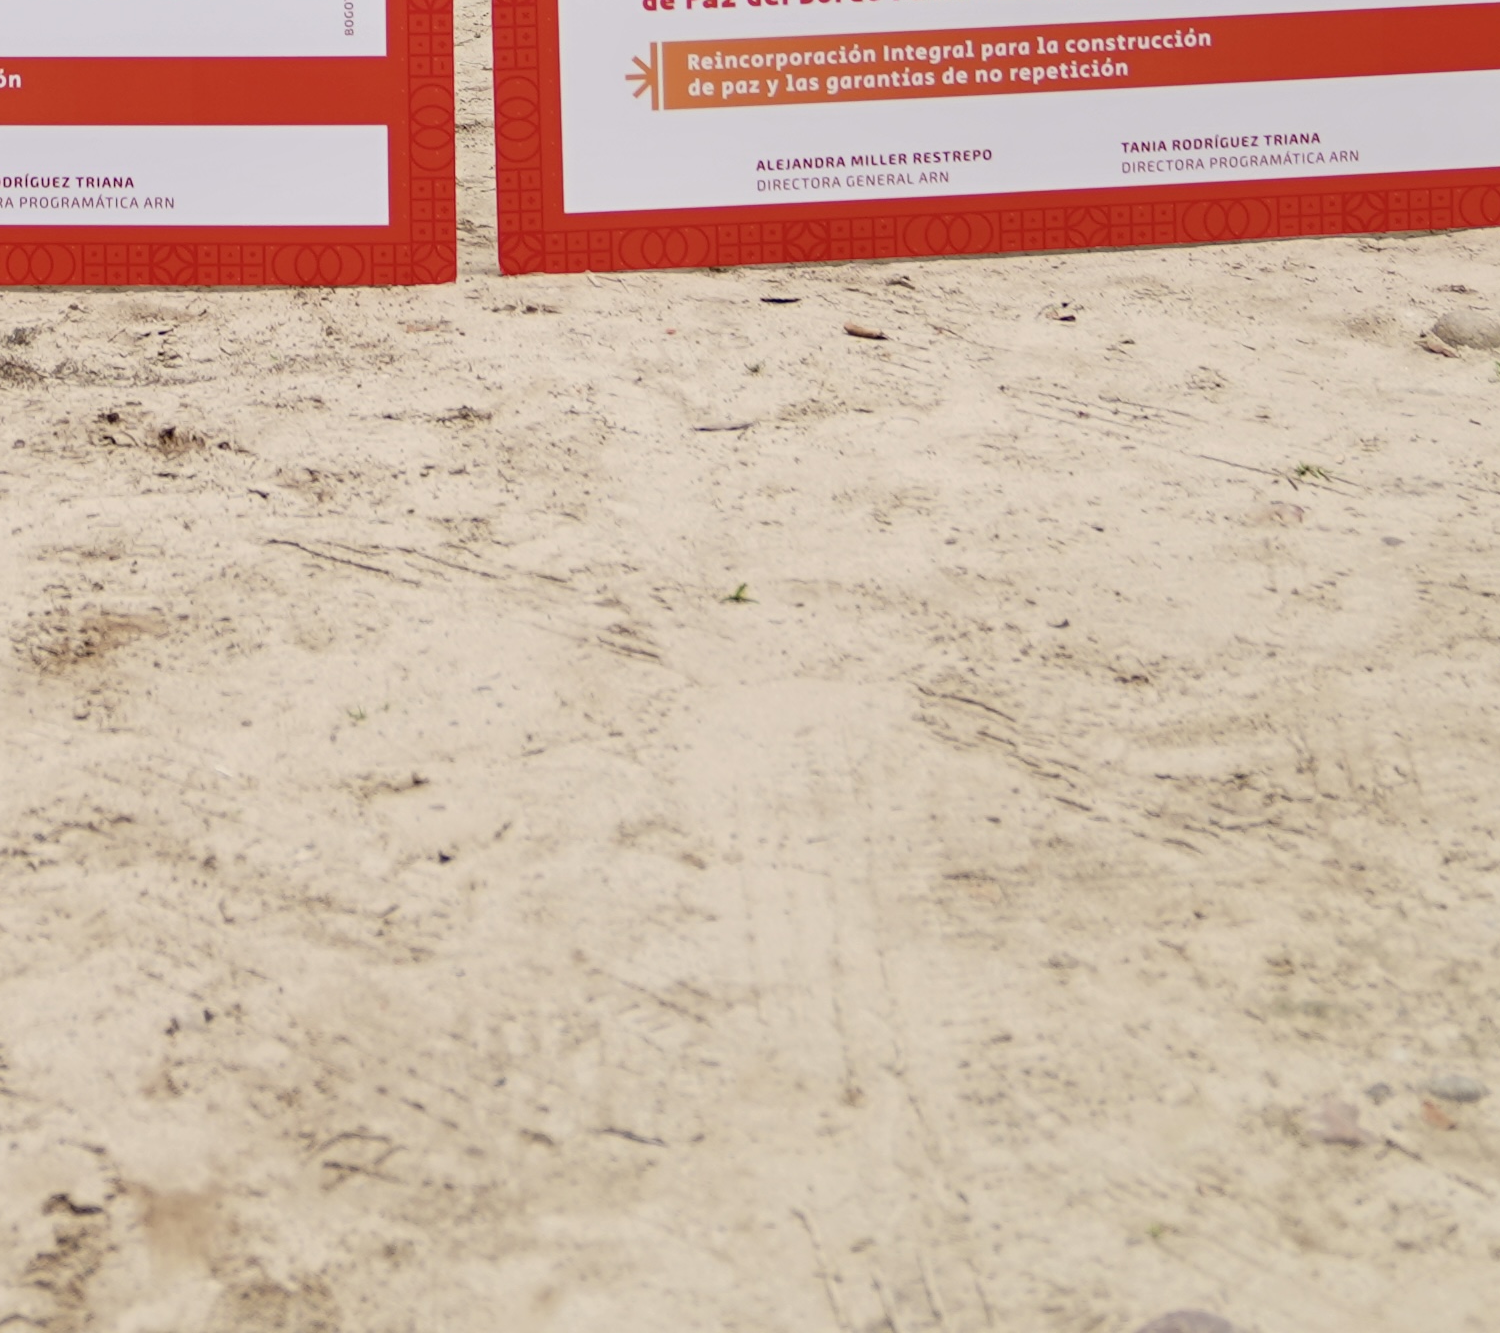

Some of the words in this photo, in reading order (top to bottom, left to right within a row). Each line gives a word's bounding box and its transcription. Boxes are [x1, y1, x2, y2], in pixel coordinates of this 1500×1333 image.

[687, 43, 876, 71] Reincorporación
[883, 39, 975, 65] Integral
[981, 41, 1030, 62] para
[1036, 36, 1059, 54] la
[1065, 27, 1211, 53] construcción
[687, 77, 715, 97] de
[721, 79, 760, 98] paz
[765, 78, 779, 97] y
[785, 73, 820, 92] las
[826, 67, 935, 94] garantías
[941, 66, 968, 85] de
[975, 68, 1003, 83] no
[1009, 57, 1128, 85] repetición
